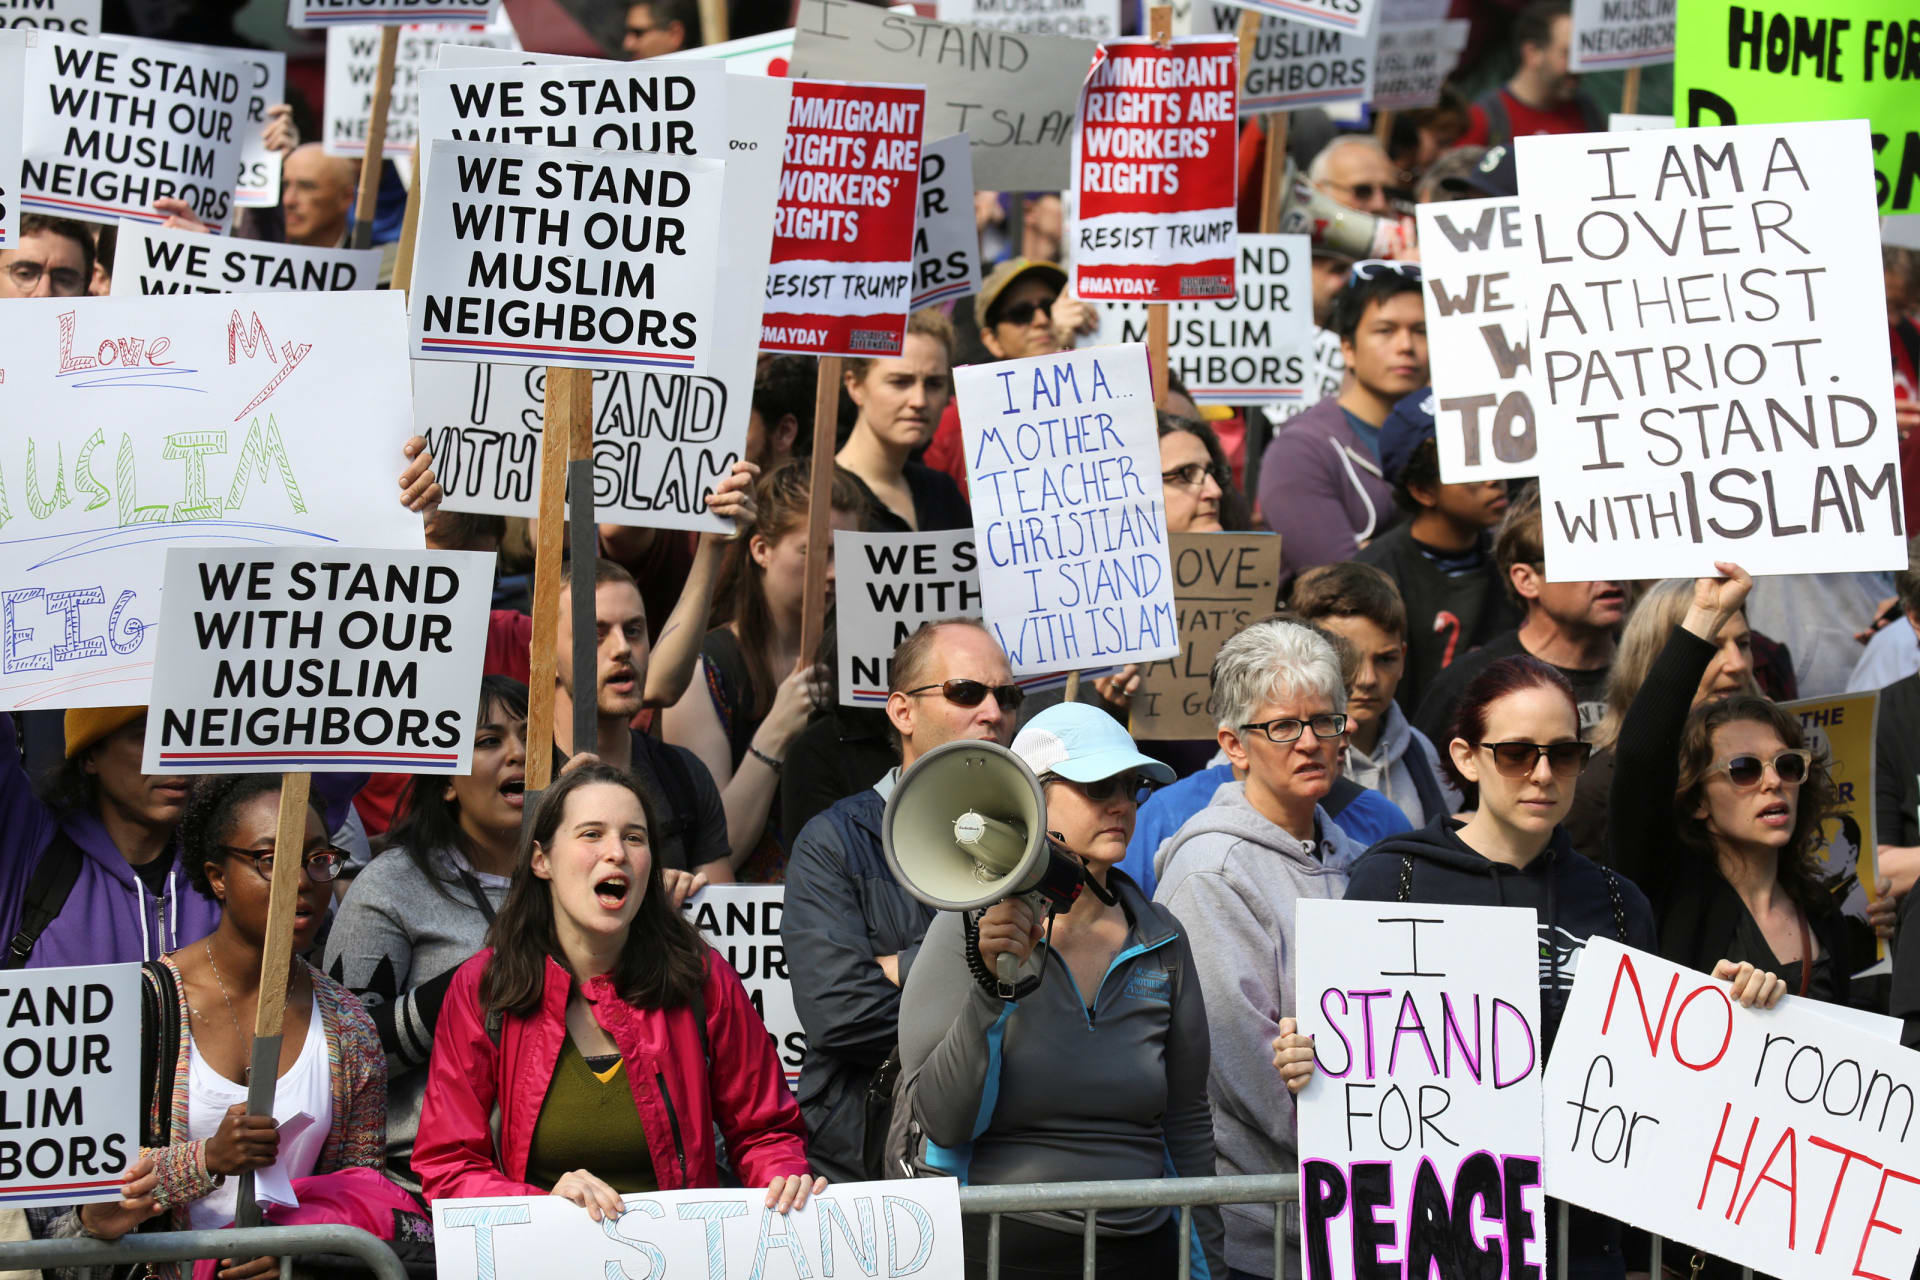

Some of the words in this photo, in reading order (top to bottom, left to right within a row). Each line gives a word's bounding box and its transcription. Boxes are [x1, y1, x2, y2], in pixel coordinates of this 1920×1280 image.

[875, 16, 1029, 72] STAND
[1253, 32, 1342, 62] USLIM
[1728, 5, 1851, 82] HOME
[1863, 19, 1920, 82] FOR
[54, 45, 118, 84] WE
[129, 57, 239, 104] STAND
[450, 82, 524, 119] WE
[540, 76, 696, 117] STAND
[1091, 55, 1232, 89] IMMIGRANT
[1245, 59, 1366, 95] GHBORS
[50, 83, 156, 129] WITH
[168, 103, 233, 144] OUR
[788, 96, 920, 134] IMMIGRANT
[1086, 92, 1182, 125] RIGHTS
[1187, 90, 1235, 122] ARE
[64, 126, 215, 179] MUSLIM
[593, 120, 697, 156] OUR
[784, 133, 867, 169] RIGHTS
[871, 139, 918, 172] ARE
[1085, 127, 1217, 160] WORKERS'
[21, 158, 231, 221] NEIGHBORS
[457, 155, 523, 196] WE
[536, 161, 691, 208] STAND
[778, 170, 899, 208] WORKERS'
[1082, 163, 1180, 195] RIGHTS
[1587, 146, 1637, 202] I
[1655, 142, 1745, 200] AM
[1762, 137, 1810, 192] A
[452, 202, 570, 247] WITH
[584, 211, 687, 256] OUR
[773, 206, 860, 243] RIGHTS
[1080, 225, 1160, 251] RESIST
[1167, 221, 1234, 247] TRUMP
[1434, 206, 1523, 253] WE
[1535, 200, 1811, 264] LOVER
[144, 237, 210, 278] WE
[221, 251, 358, 292] STAND
[467, 250, 655, 299] MUSLIM
[765, 274, 836, 299] RESIST
[841, 274, 909, 300] TRUMP
[1428, 271, 1514, 318] WE
[1540, 267, 1827, 339] ATHEIST
[423, 294, 697, 349] NEIGHBORS
[56, 309, 176, 374] Love
[227, 308, 313, 422] My
[996, 370, 1021, 415] I
[1032, 362, 1082, 411] AM
[1178, 356, 1304, 385] HBORS
[1545, 338, 1841, 406] PATRIOT.
[521, 365, 729, 443] SAND
[975, 413, 1125, 470] MOTHER
[1576, 413, 1625, 472] I
[1639, 394, 1878, 468] STAND
[0, 412, 308, 529] USLIM
[566, 440, 739, 515] SLAM
[977, 455, 1145, 517] TEACHER
[1555, 490, 1682, 545] WITH
[1680, 462, 1904, 545] ISLAM
[864, 544, 937, 575] WE
[987, 500, 1161, 568] CHRISTIAN
[198, 562, 275, 601] WE
[287, 561, 460, 605] STAND
[1023, 568, 1048, 614] I
[1058, 553, 1162, 608] STAND
[1176, 547, 1272, 590] OVE.
[866, 580, 982, 613] WITH
[1176, 607, 1251, 632] HAT'S
[194, 610, 324, 650] WITH
[338, 610, 453, 654] OUR
[994, 612, 1080, 667] WITH
[1085, 602, 1177, 656] ISLAM
[213, 658, 418, 699] MUSLIM
[1143, 692, 1163, 718] I
[161, 706, 462, 748] NEIGHBORS
[1800, 706, 1845, 729] THE
[728, 945, 790, 980] UR
[1377, 918, 1446, 977] I
[3, 1033, 113, 1079] OUR
[1308, 987, 1536, 1090] STAND
[1601, 953, 1733, 1072] NO
[1754, 1033, 1914, 1142] room
[0, 1085, 84, 1131] LIM
[1345, 1083, 1460, 1152] FOR
[1566, 1055, 1660, 1169] for
[1696, 1101, 1920, 1280] HATE
[601, 1194, 935, 1280] STAND
[1301, 1149, 1543, 1280] PEACE
